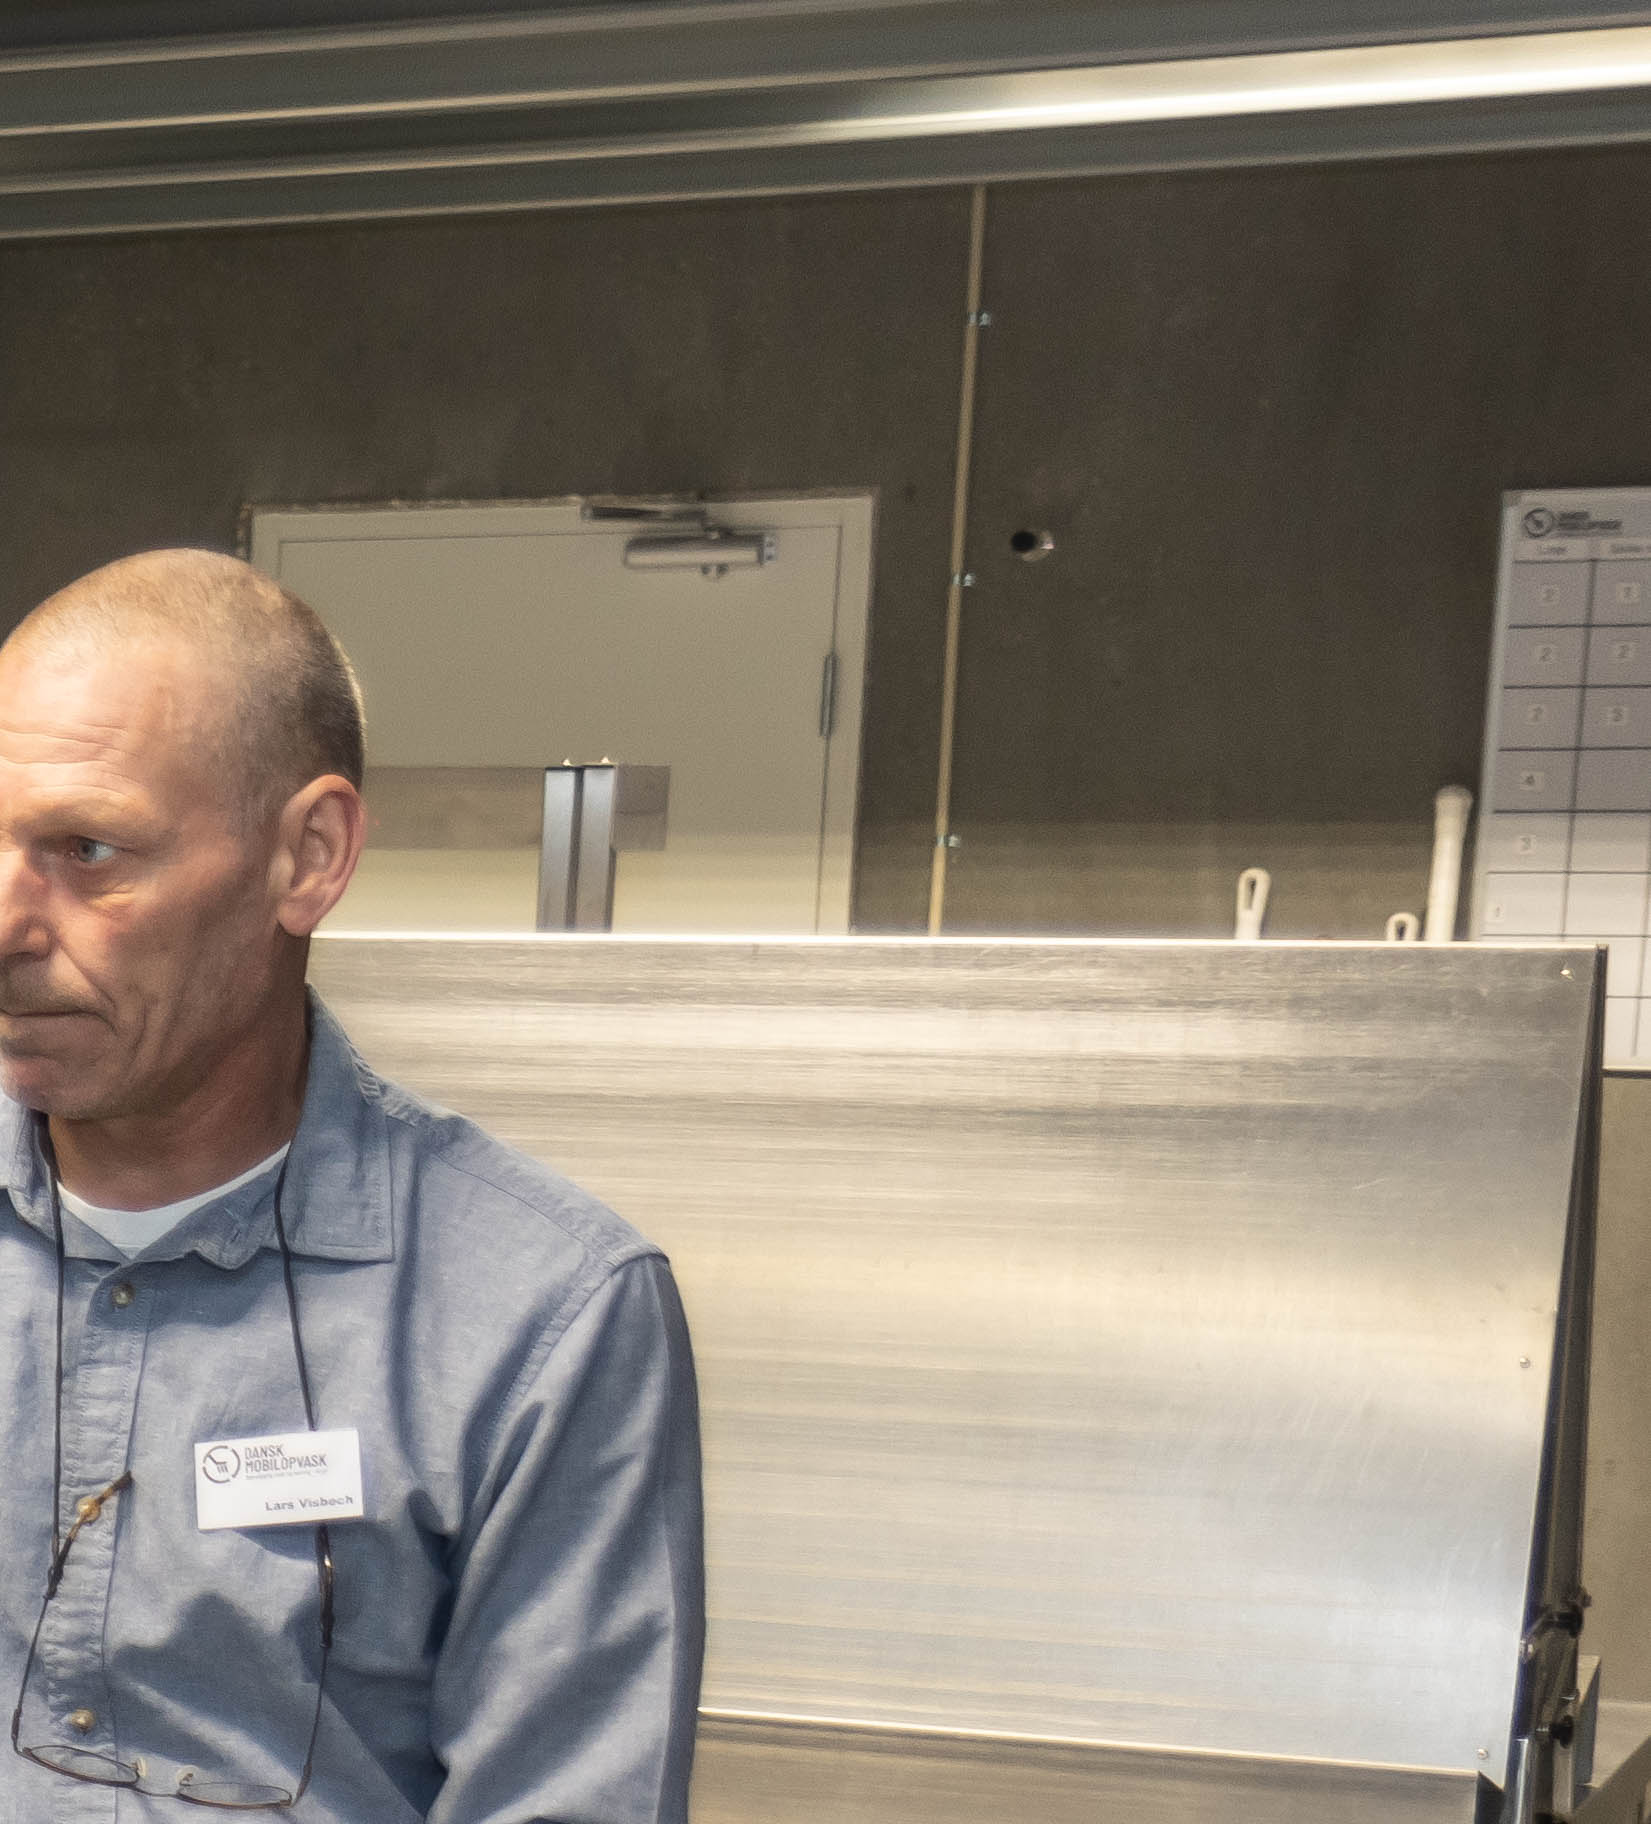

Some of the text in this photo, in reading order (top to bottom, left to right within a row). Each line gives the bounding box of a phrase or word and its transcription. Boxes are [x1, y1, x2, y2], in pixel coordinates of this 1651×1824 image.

[244, 1444, 284, 1458] DANSK
[245, 1454, 328, 1473] MOBILOPVASK
[265, 1501, 294, 1512] Lars
